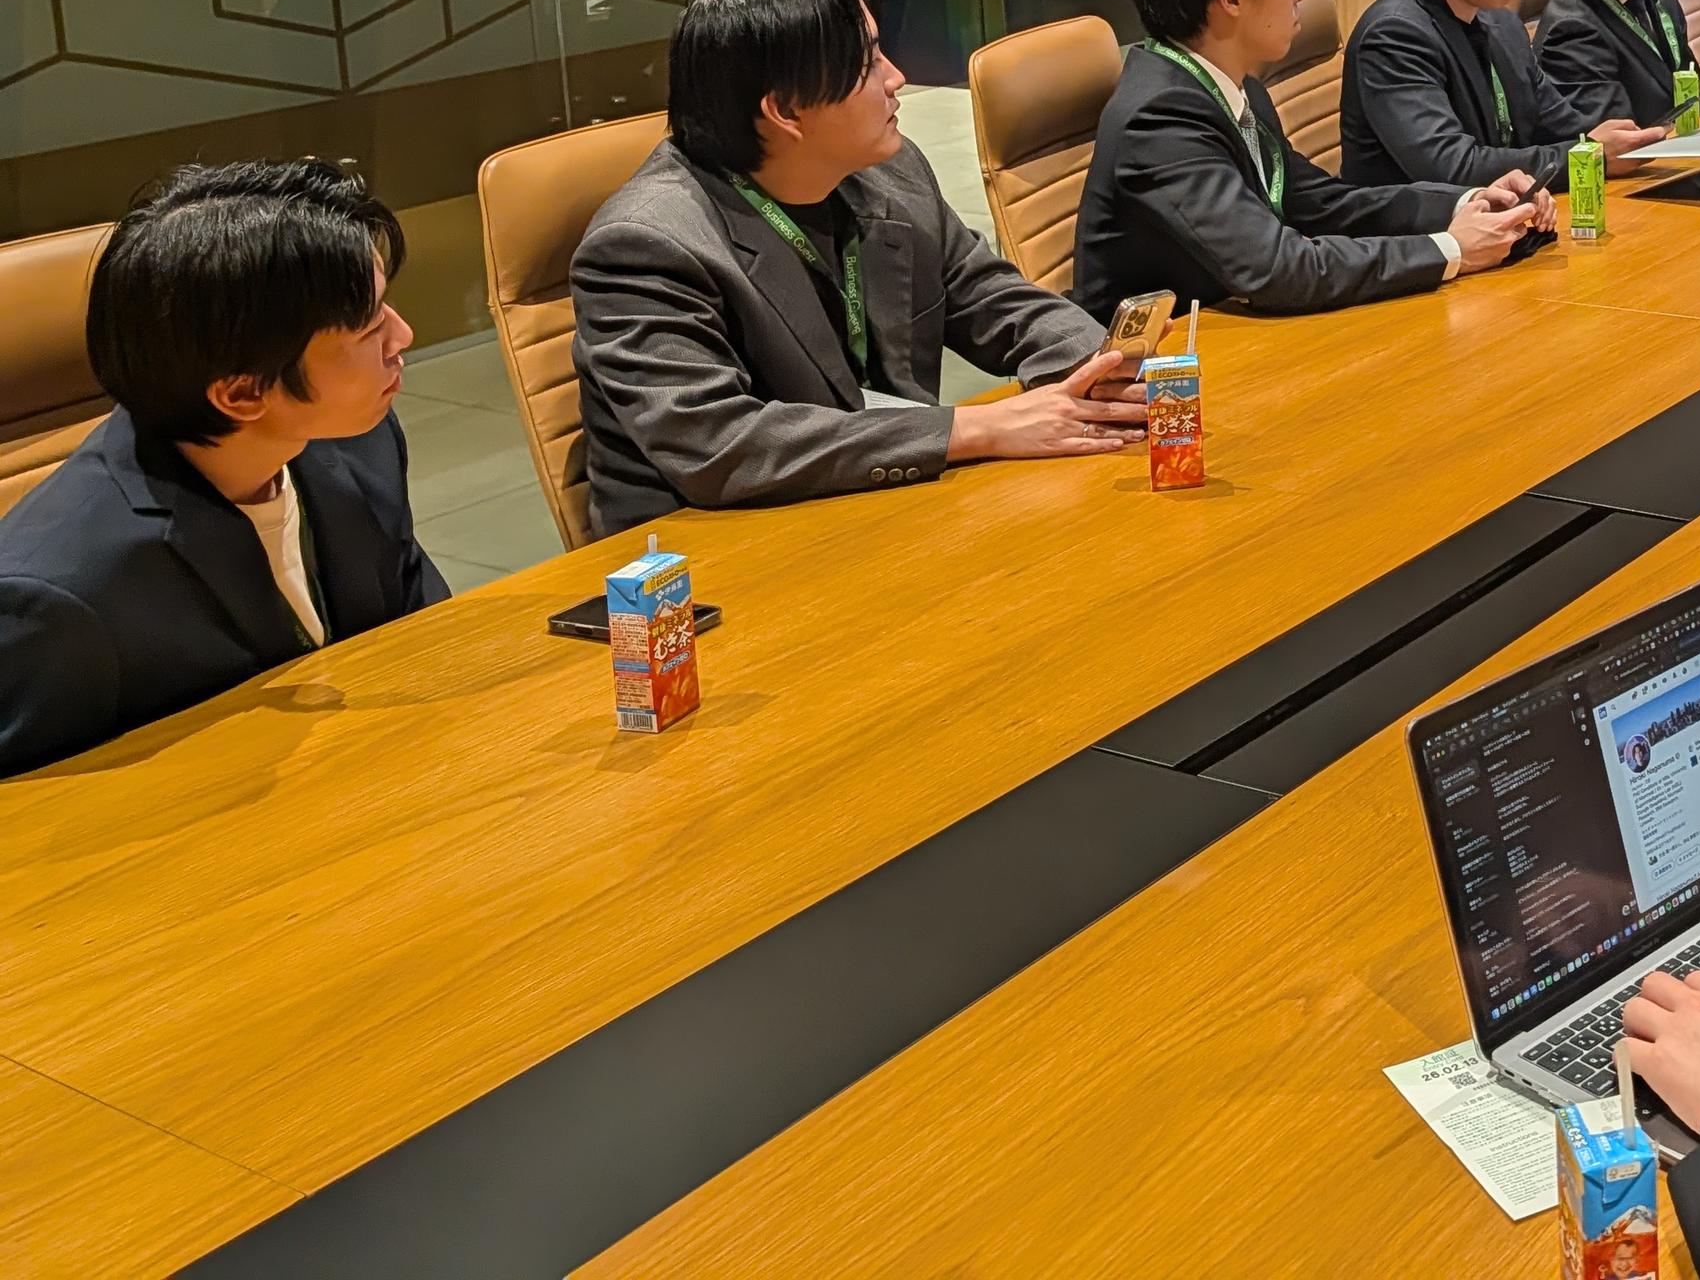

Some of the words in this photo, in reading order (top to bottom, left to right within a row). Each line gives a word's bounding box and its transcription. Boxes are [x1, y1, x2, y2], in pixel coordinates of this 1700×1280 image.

[1179, 55, 1199, 76] Guest
[761, 202, 795, 240] Business
[794, 237, 816, 263] Guest
[846, 256, 856, 299] Business
[1151, 413, 1198, 435] むぎ茶
[654, 620, 694, 660] むぎ茶
[1422, 1057, 1479, 1081] 26.02.13
[1489, 1131, 1538, 1152] Instructions
